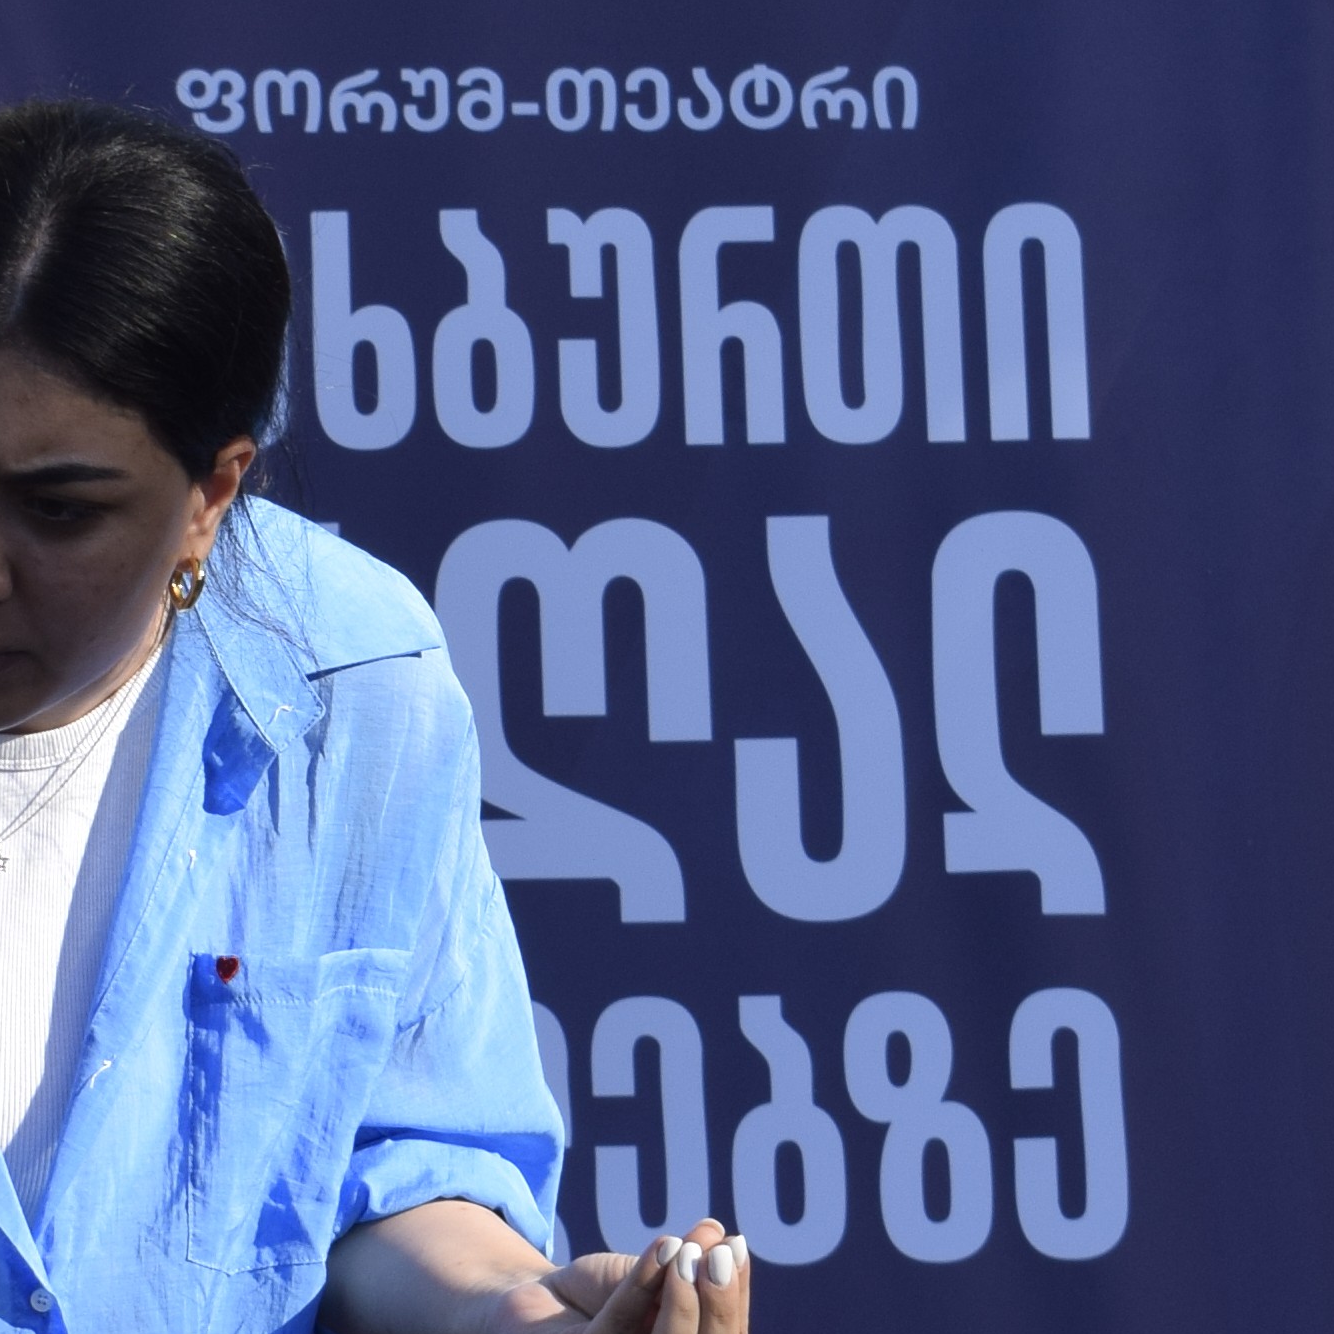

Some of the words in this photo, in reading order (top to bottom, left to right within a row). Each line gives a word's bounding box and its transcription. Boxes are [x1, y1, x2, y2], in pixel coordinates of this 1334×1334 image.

[175, 64, 919, 134] ფორუმ-თეატრი
[310, 202, 1091, 451] ხბურთი
[318, 510, 1106, 923] ღალ
[531, 987, 1129, 1267] ებზე
